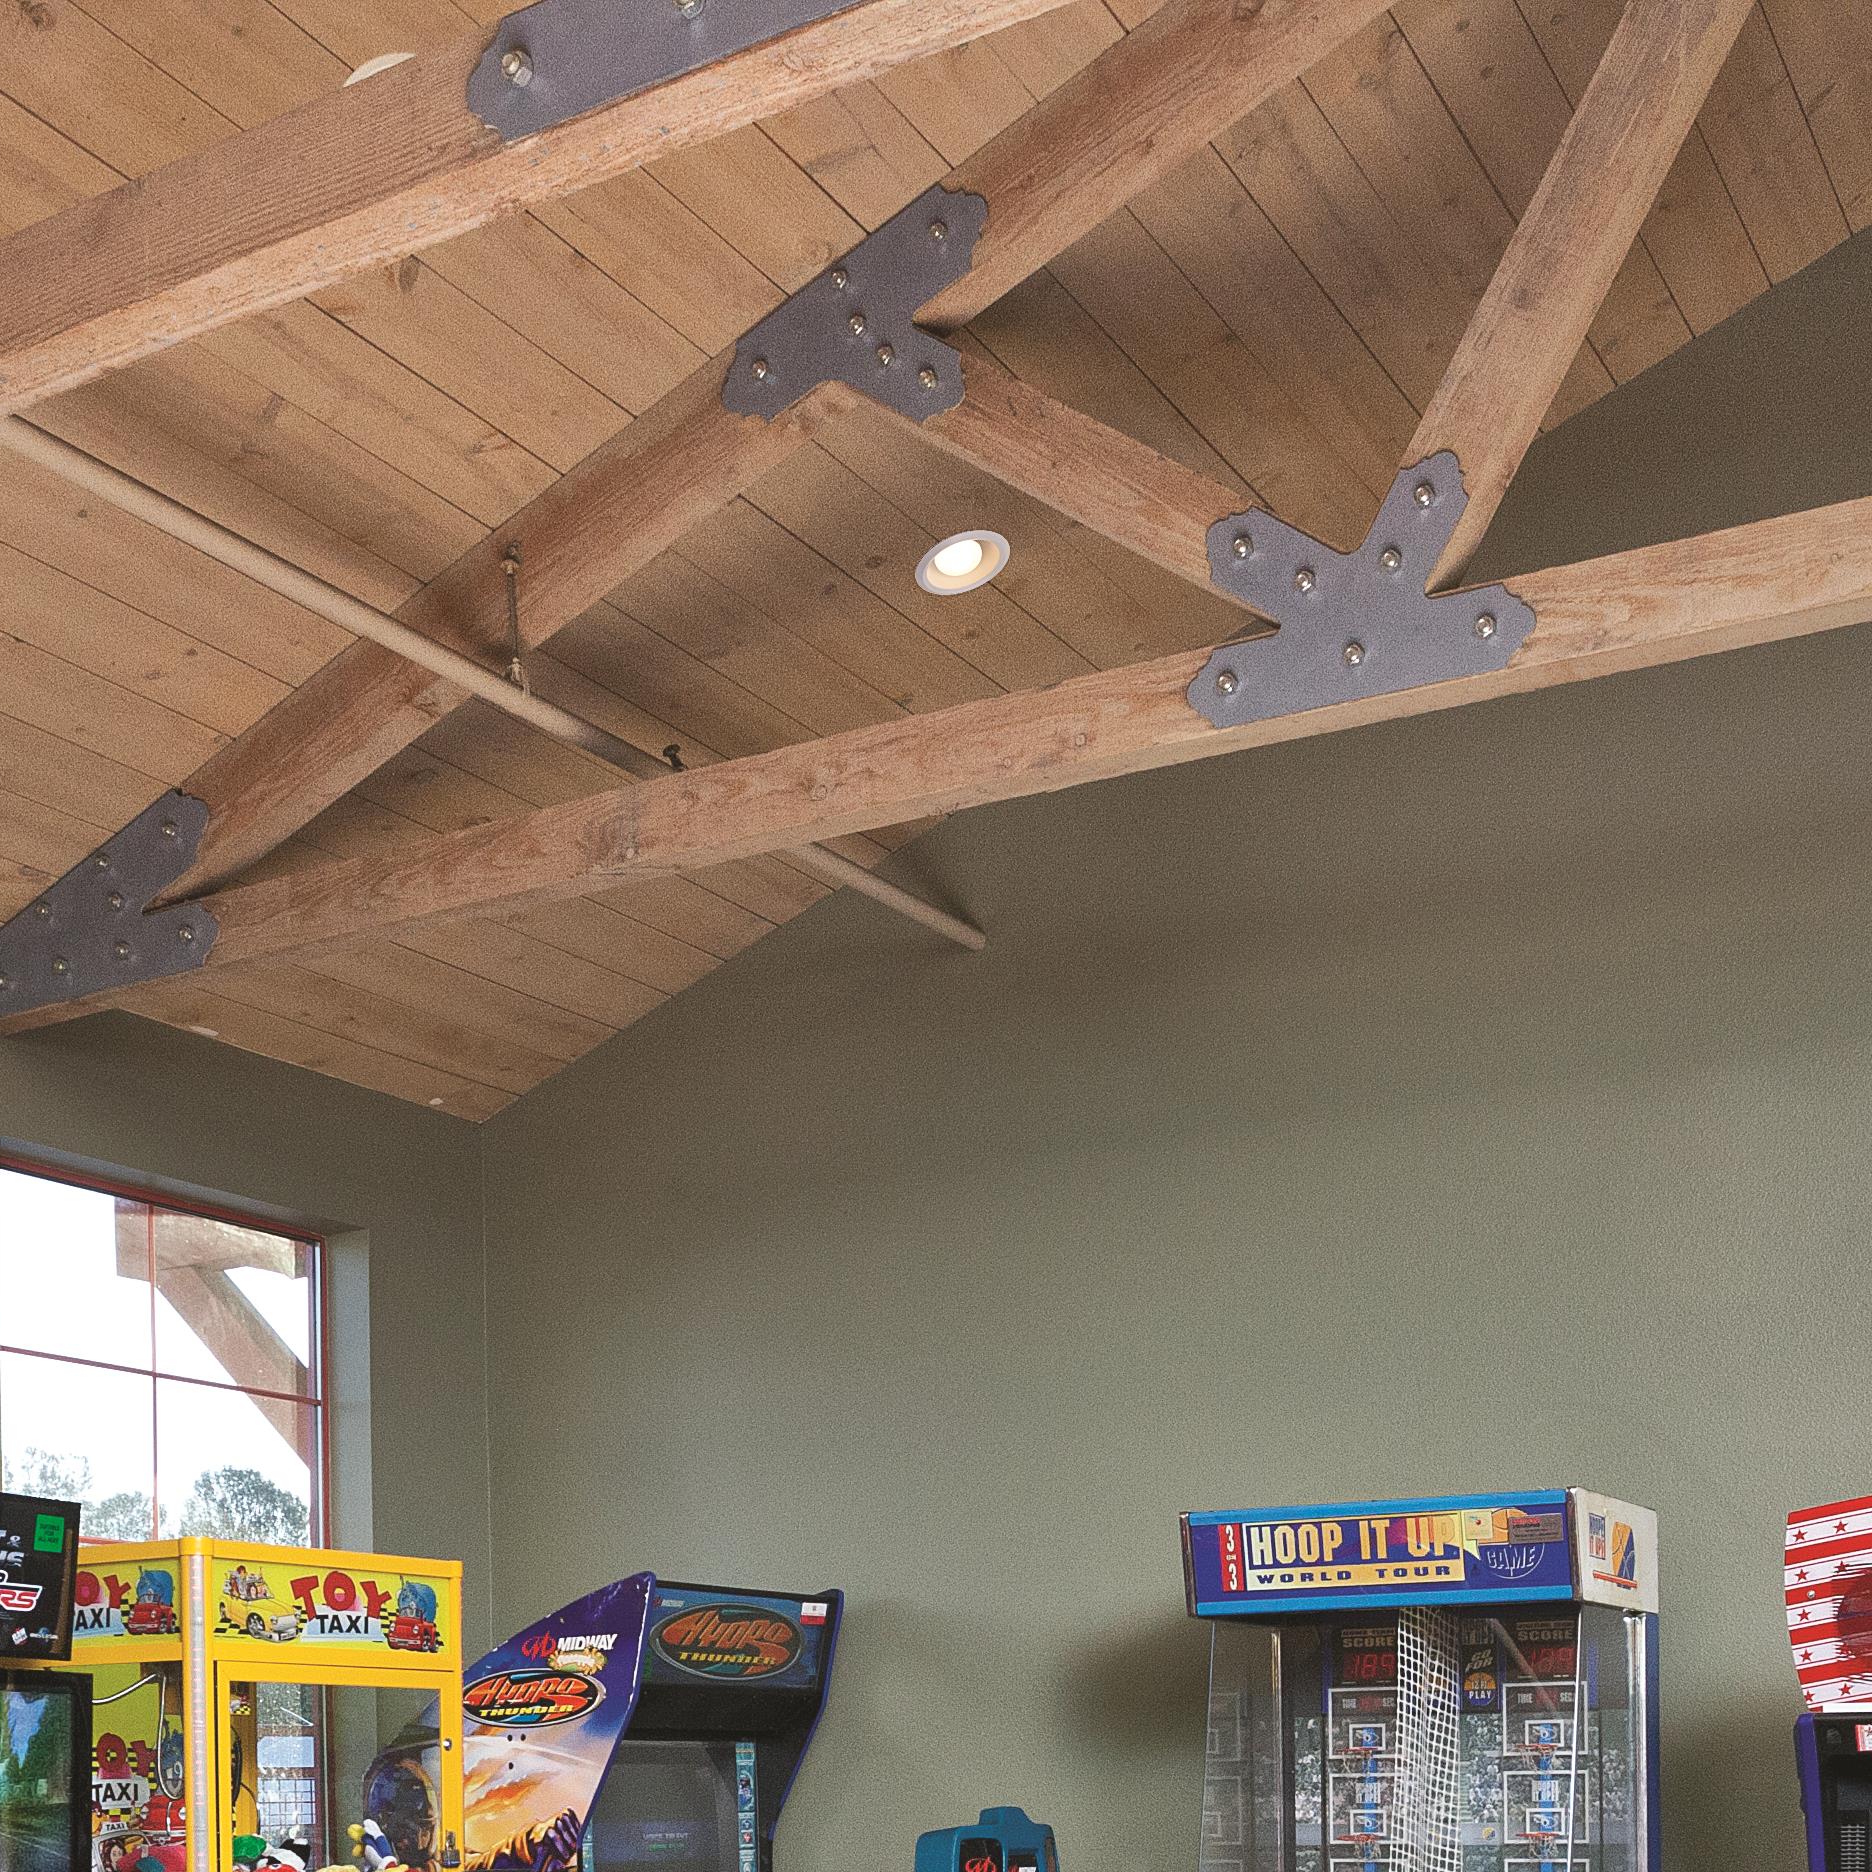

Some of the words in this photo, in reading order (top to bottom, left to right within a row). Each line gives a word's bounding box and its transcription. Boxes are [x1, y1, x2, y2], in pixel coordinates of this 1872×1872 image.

[7, 1535, 21, 1548] &
[1225, 1527, 1235, 1551] 3
[1252, 1521, 1346, 1566] HOOP
[1359, 1519, 1390, 1560] IT
[1407, 1516, 1457, 1558] UP
[1487, 1544, 1537, 1571] GAME
[1228, 1566, 1238, 1590] 3
[1257, 1570, 1352, 1585] WORLD
[1376, 1565, 1453, 1580] TOUR
[290, 1570, 392, 1622] TOY
[315, 1614, 369, 1634] TAXI
[557, 1633, 618, 1651] MIDWAY
[1342, 1635, 1395, 1648] SCORE
[1517, 1629, 1574, 1641] SCORE
[679, 1652, 779, 1666] THUNDER
[1469, 1691, 1492, 1699] PLAY
[479, 1703, 575, 1717] THUNDER
[92, 1782, 139, 1804] TAXI
[104, 1821, 126, 1832] TAXI
